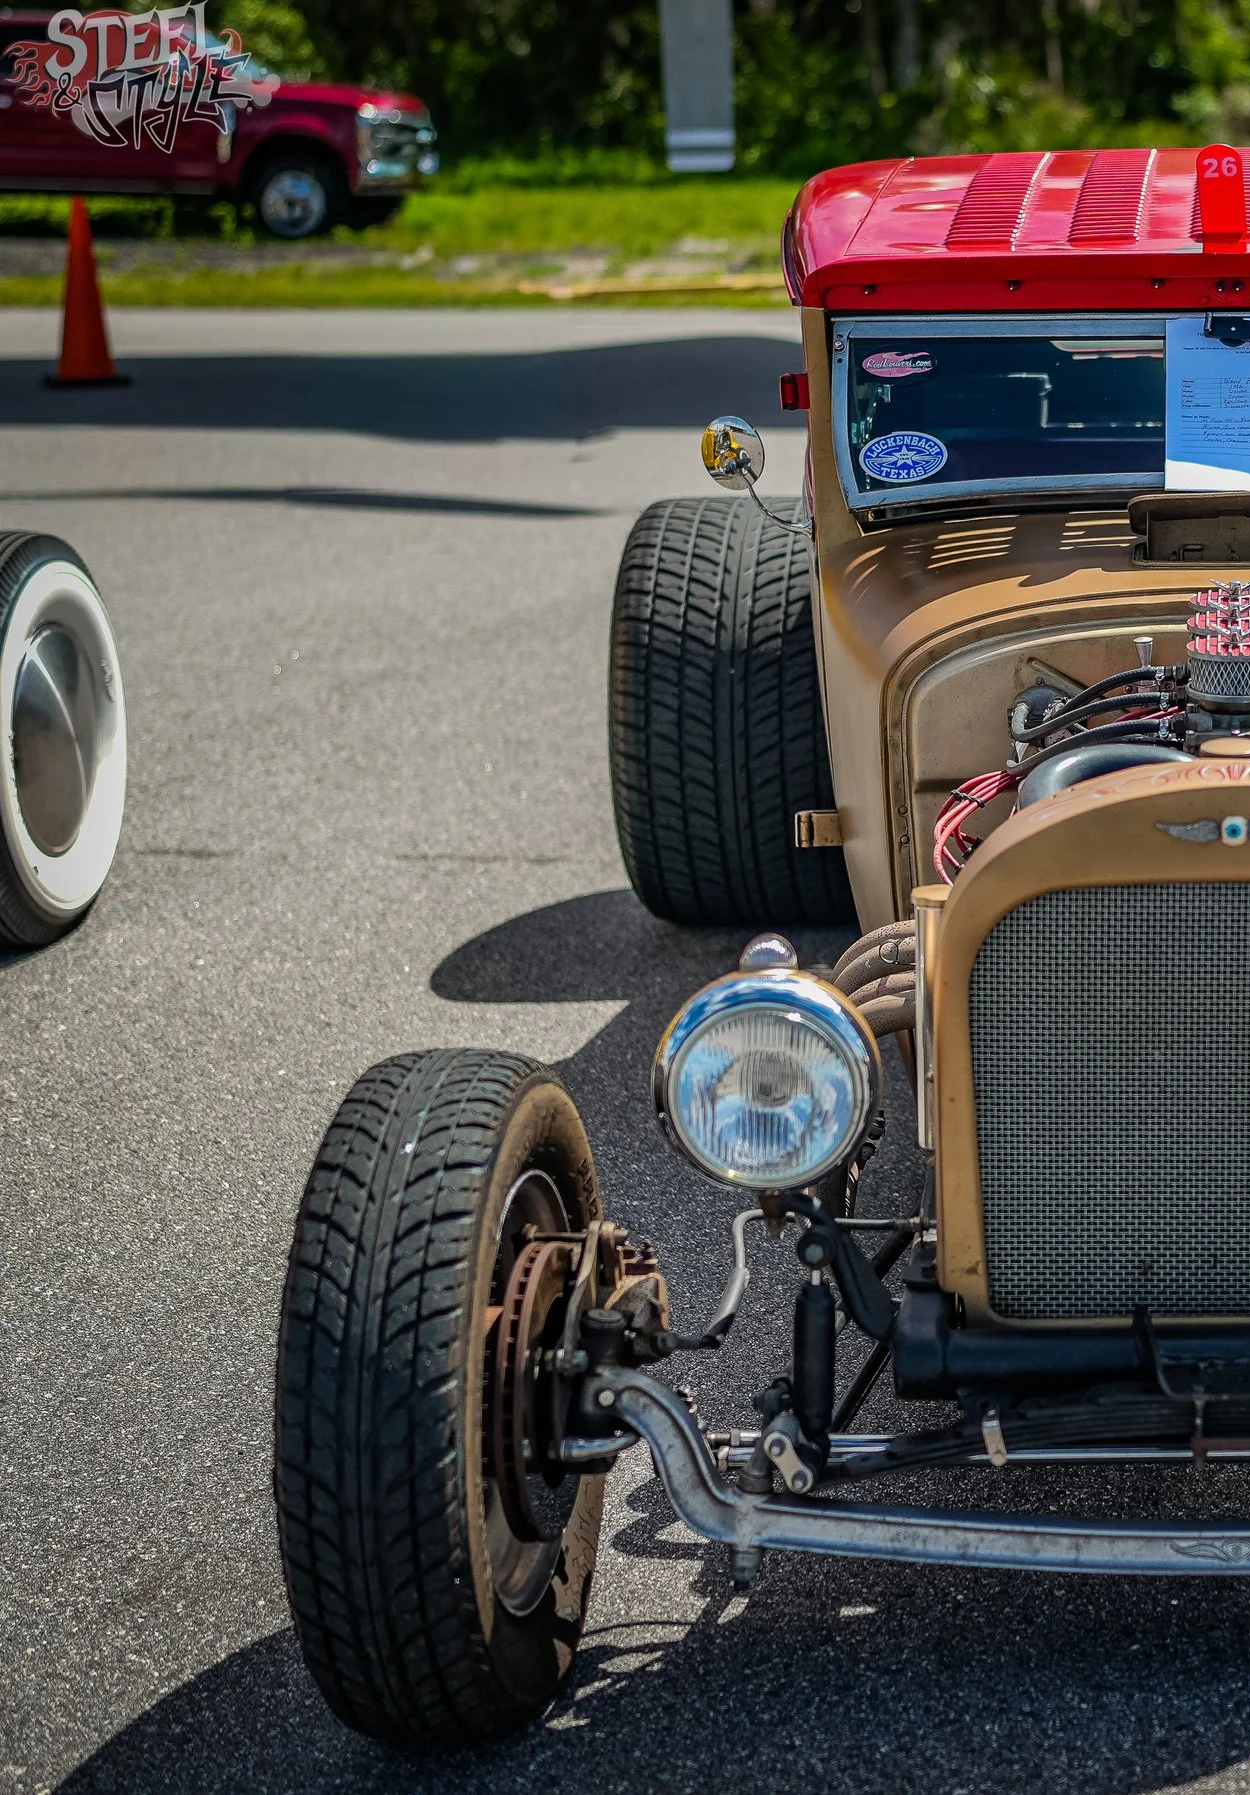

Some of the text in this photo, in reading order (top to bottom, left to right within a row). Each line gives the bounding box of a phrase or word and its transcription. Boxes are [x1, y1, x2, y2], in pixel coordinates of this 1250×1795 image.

[1203, 156, 1238, 178] 26
[866, 436, 941, 458] LUCKENBACH
[880, 466, 925, 478] TEXAS
